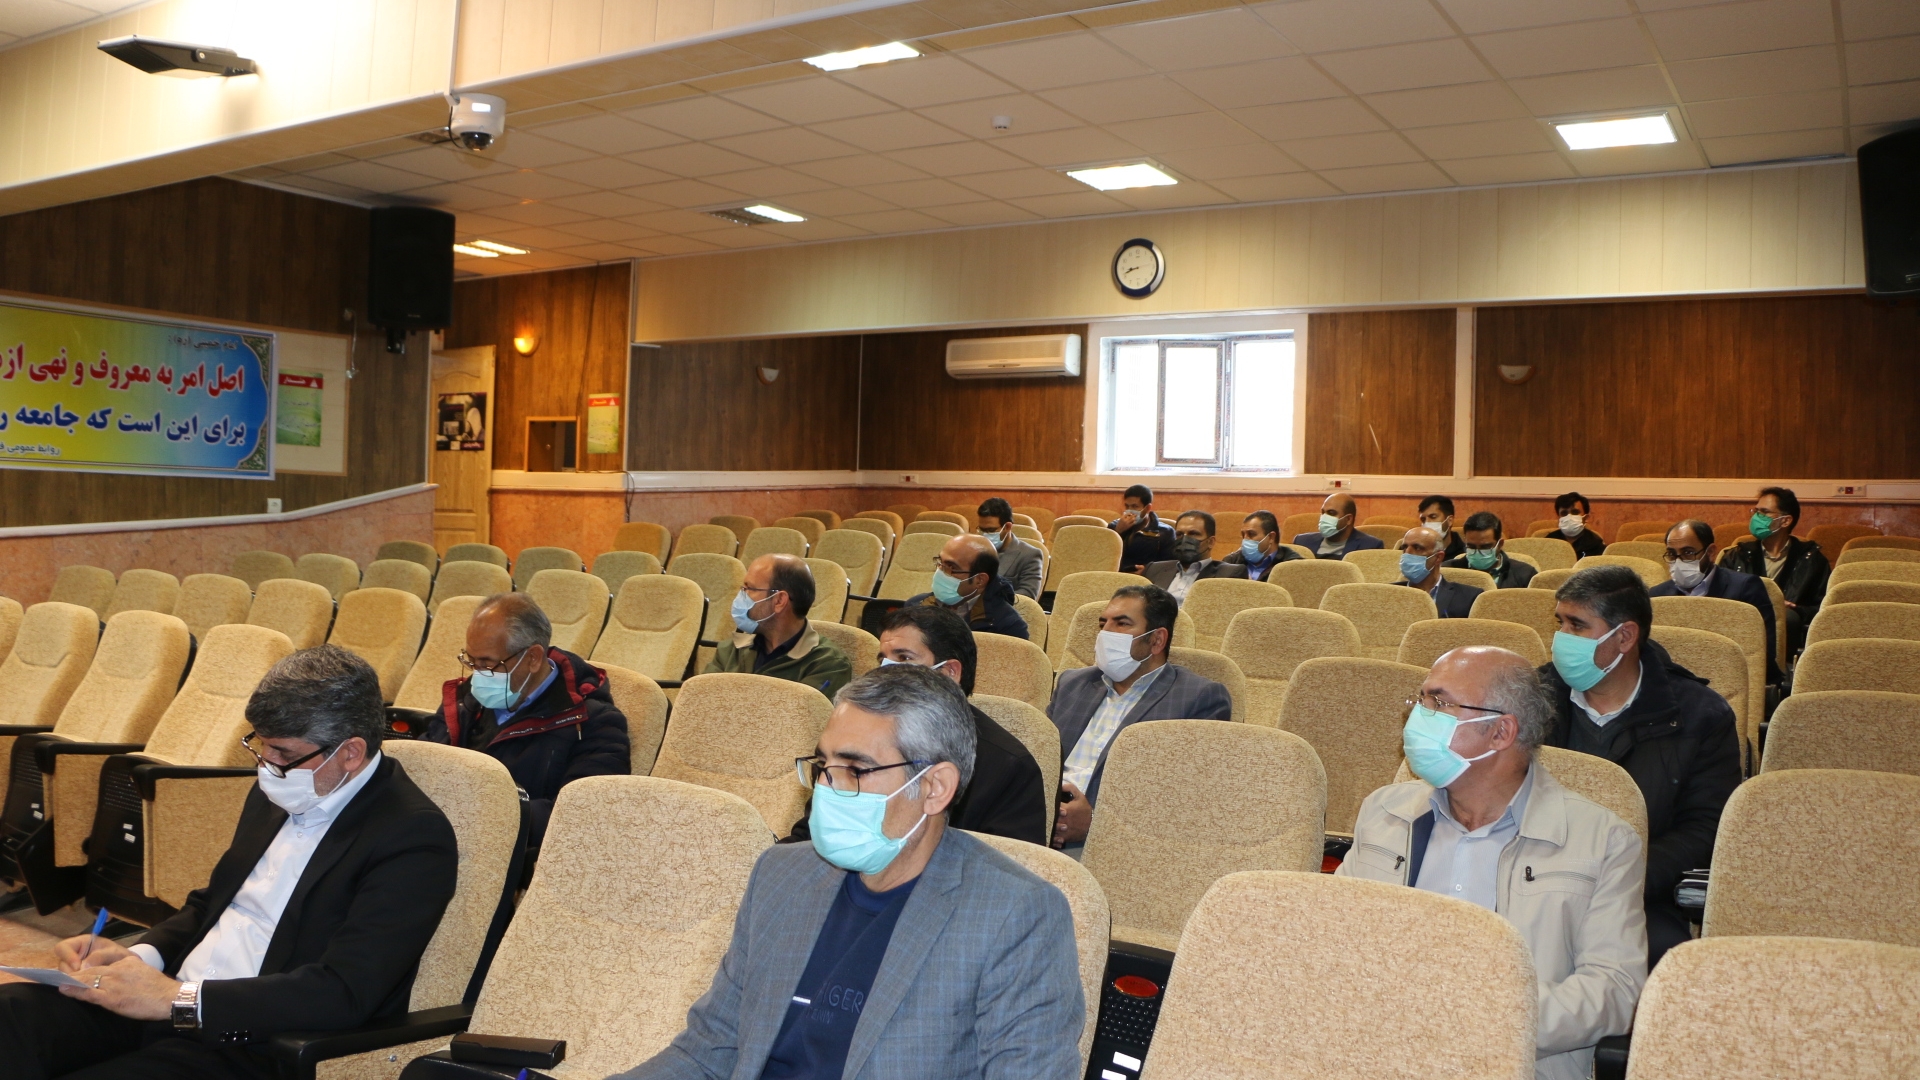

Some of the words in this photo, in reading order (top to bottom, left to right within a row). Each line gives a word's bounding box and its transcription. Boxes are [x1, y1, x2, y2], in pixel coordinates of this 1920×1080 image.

[2, 343, 24, 380] از
[29, 348, 67, 382] نهی
[71, 361, 84, 386] و
[89, 350, 151, 390] معروف
[156, 365, 173, 393] به
[176, 363, 204, 395] امر
[208, 365, 243, 397] اصل
[15, 403, 80, 434] جامعه
[86, 407, 113, 430] که
[117, 411, 161, 433] است
[166, 414, 198, 441] این
[203, 417, 246, 446] برای
[7, 445, 36, 454] عمومی
[37, 444, 60, 456] روابط
